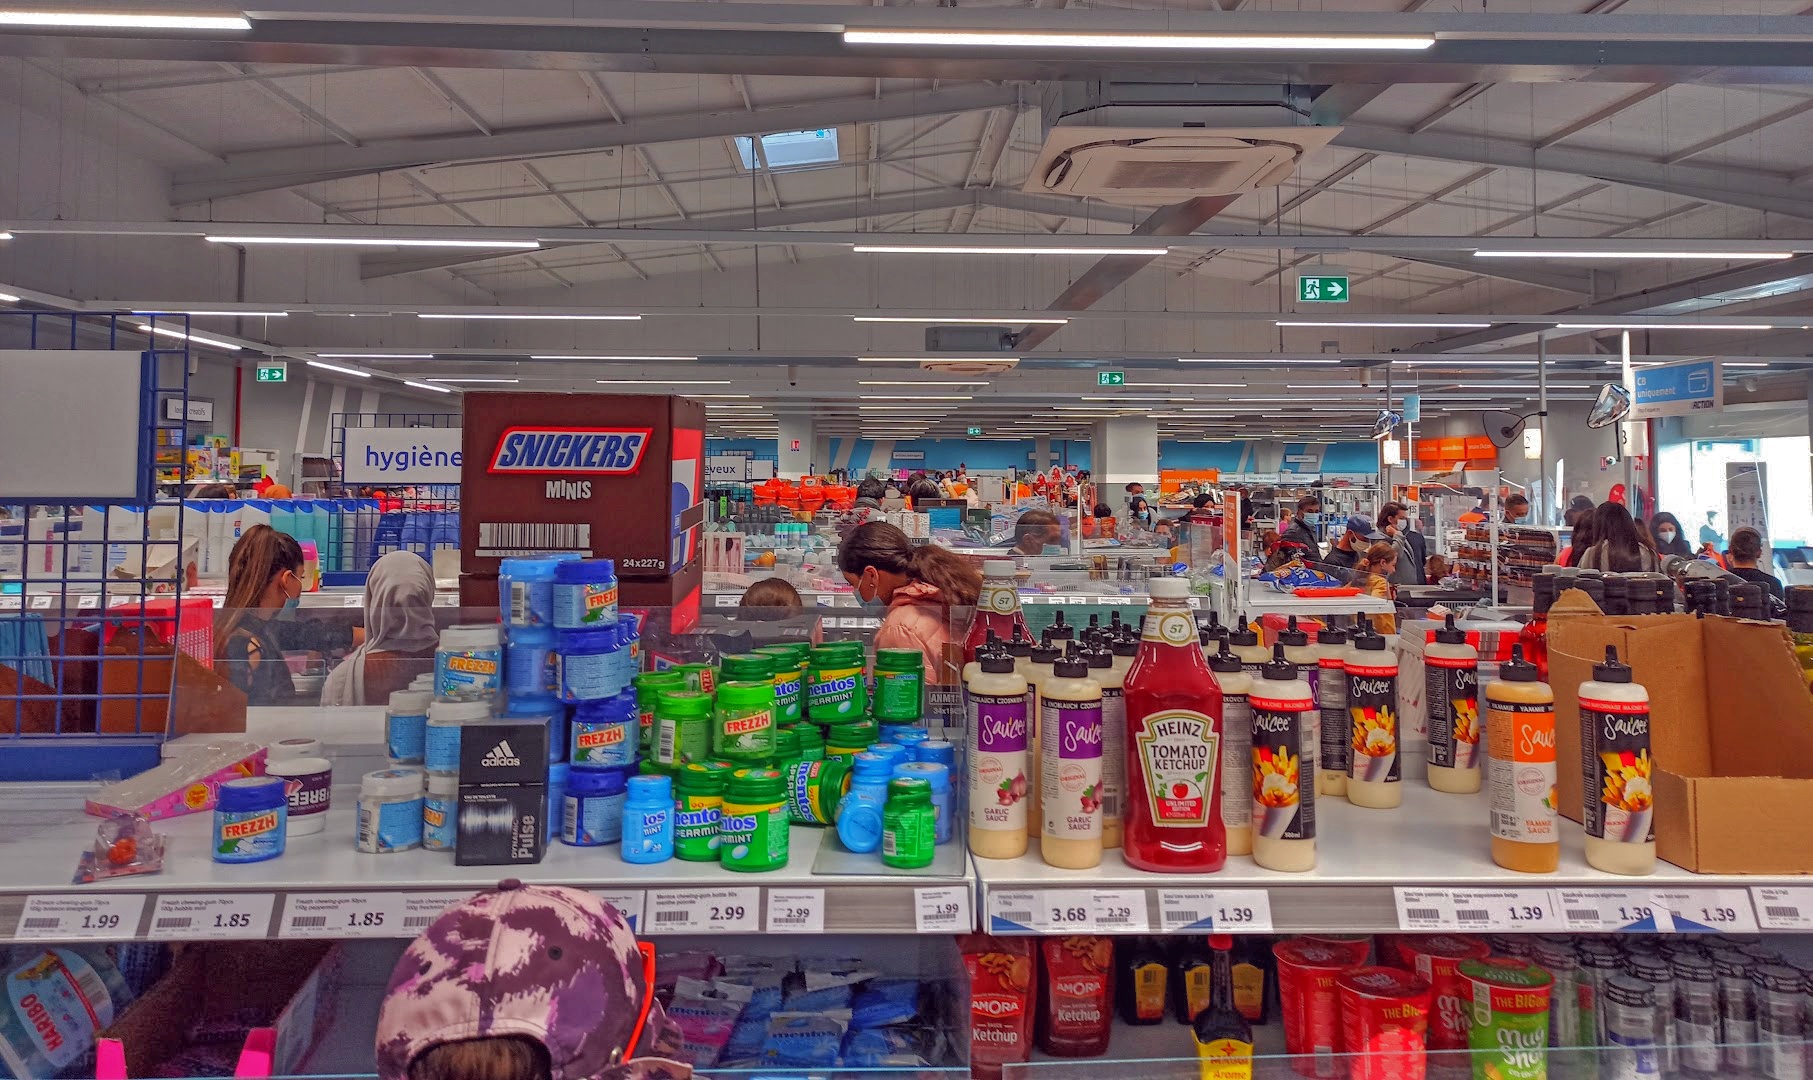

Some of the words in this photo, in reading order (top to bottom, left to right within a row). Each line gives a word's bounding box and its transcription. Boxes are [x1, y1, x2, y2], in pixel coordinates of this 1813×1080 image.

[1637, 377, 1646, 386] CB
[1637, 386, 1676, 398] uniquement
[1692, 400, 1714, 410] ACTION
[366, 444, 462, 472] hygiène
[499, 434, 643, 468] SNICKERS
[546, 480, 592, 500] MINIS
[623, 558, 665, 569] 24x227g
[1170, 624, 1184, 634] 57
[450, 657, 497, 674] FREZZH
[726, 715, 769, 734] FREZZH
[1156, 721, 1201, 737] HEINZ
[580, 728, 622, 746] FREZZH
[1150, 745, 1207, 759] TOMATO
[481, 757, 520, 767] adidas
[1155, 759, 1206, 770] KETCHUP
[225, 814, 276, 838] FREZZH
[518, 815, 535, 858] Pulse
[710, 906, 745, 921] 2.99
[786, 908, 810, 918] 2.99
[936, 904, 959, 914] 1.99
[1052, 908, 1086, 922] 3.68
[1108, 908, 1130, 917] 2.29
[1219, 908, 1252, 922] 1.39
[1508, 906, 1542, 920] 1.39
[1619, 907, 1652, 921] 1.39
[1702, 908, 1736, 922] 1.39
[81, 915, 120, 928] 1.99
[214, 914, 250, 927] 1.85
[348, 912, 384, 926] 1.85
[1057, 982, 1101, 995] AMORA
[1316, 978, 1334, 988] THE
[972, 1000, 1019, 1014] AMORA
[1495, 996, 1514, 1008] THE
[1516, 994, 1537, 1008] BIG
[668, 1006, 729, 1016] mentos
[1058, 1008, 1100, 1022] Ketchup
[1383, 1008, 1401, 1019] THE
[20, 994, 64, 1052] HARIBO
[772, 1030, 838, 1038] mentos
[973, 1028, 1018, 1044] Ketchup
